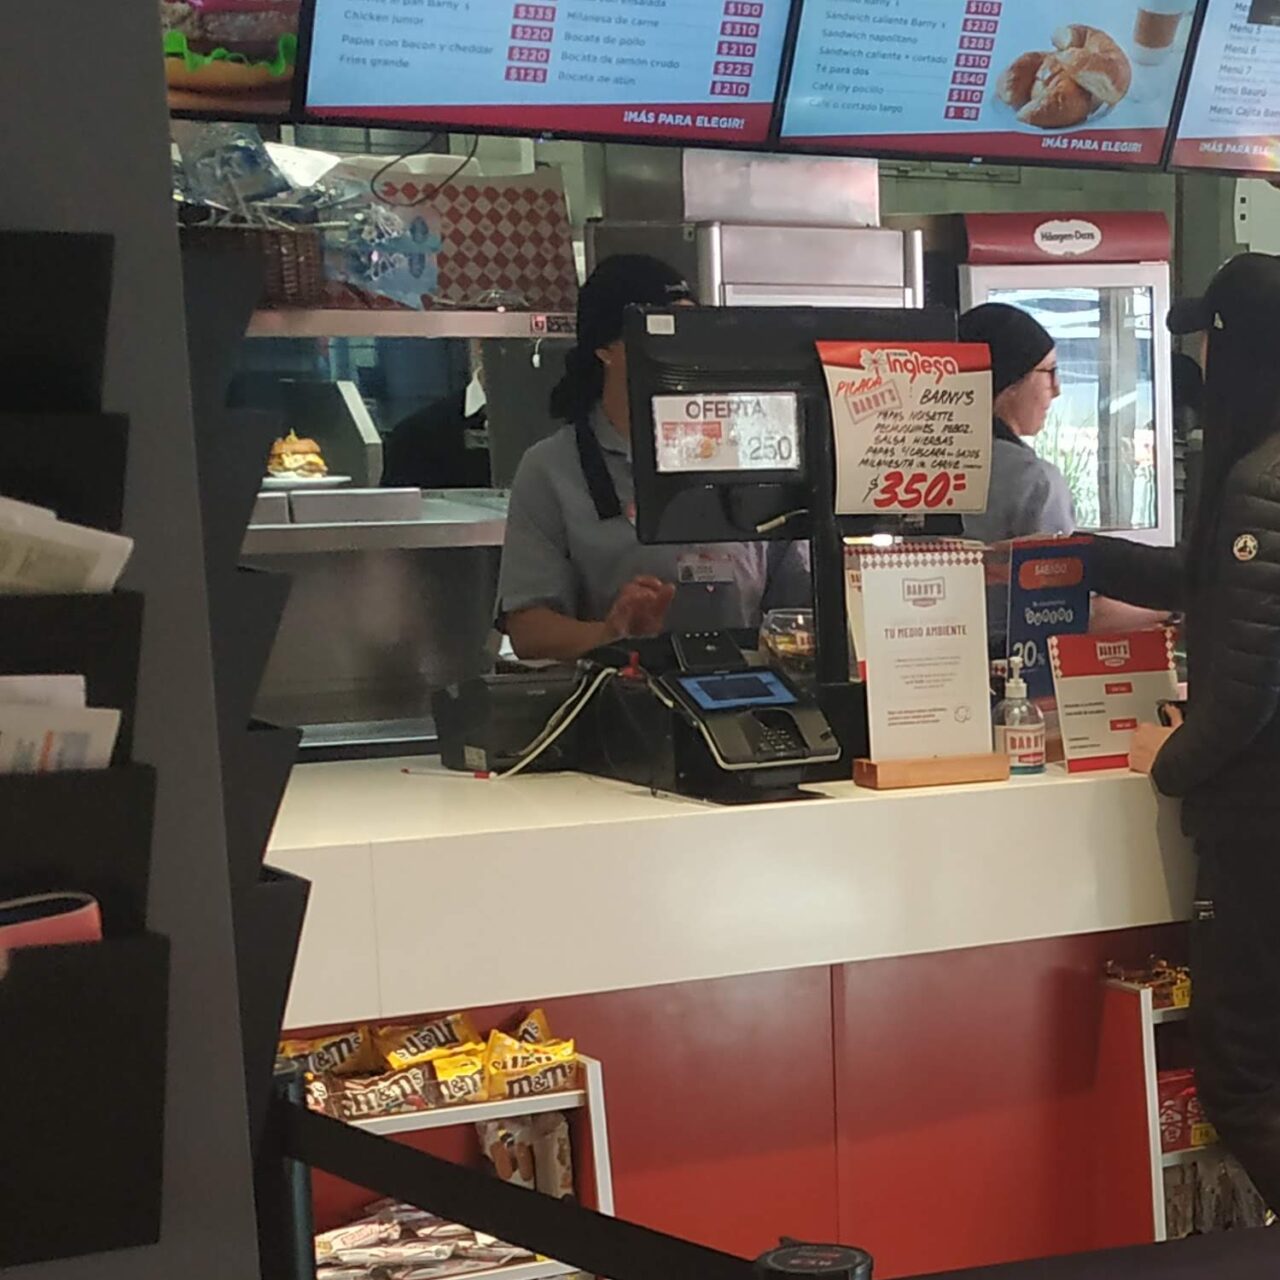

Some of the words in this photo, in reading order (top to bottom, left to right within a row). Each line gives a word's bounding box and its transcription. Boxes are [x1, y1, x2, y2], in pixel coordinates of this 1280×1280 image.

[517, 6, 553, 20] $335
[969, 2, 999, 14] $105
[344, 10, 389, 22] Chicken
[567, 12, 612, 24] Milanesa
[615, 16, 628, 25] de
[631, 19, 660, 28] carne
[826, 11, 870, 22] Sandwich
[872, 15, 908, 25] caliente
[514, 26, 550, 40] $220
[724, 22, 757, 36] $310
[966, 20, 995, 32] $230
[341, 34, 375, 46] Papas
[379, 39, 400, 47] con
[402, 40, 437, 50] bacon
[564, 32, 600, 43] Bocata
[603, 35, 616, 44] de
[619, 36, 646, 47] pollo
[822, 29, 866, 40] Sandwich
[869, 33, 918, 44] napolitano
[511, 47, 547, 61] $220
[720, 42, 753, 56] $210
[819, 46, 863, 57] Sandwich
[866, 51, 901, 61] caliente
[912, 55, 948, 64] cortado
[339, 55, 368, 66] Fries
[370, 57, 410, 68] grande
[561, 52, 597, 63] Bocata
[650, 59, 680, 69] crudo
[508, 67, 544, 81] $125
[716, 62, 750, 76] $225
[829, 67, 850, 77] para
[852, 66, 870, 76] dos
[558, 71, 594, 83] Bocata
[954, 72, 984, 84] $540
[713, 82, 747, 96] $210
[951, 89, 981, 101] $110
[879, 103, 904, 113] largo
[658, 113, 692, 126] PARA
[696, 116, 744, 130] ELEGIR!
[1070, 139, 1099, 150] PARA
[1101, 141, 1142, 152] ELEGIR!
[886, 351, 958, 385] Inglesa
[874, 435, 906, 445] SALSA
[884, 628, 895, 639] TU
[897, 627, 923, 639] MEDIO
[925, 624, 967, 637] AMBIENTE
